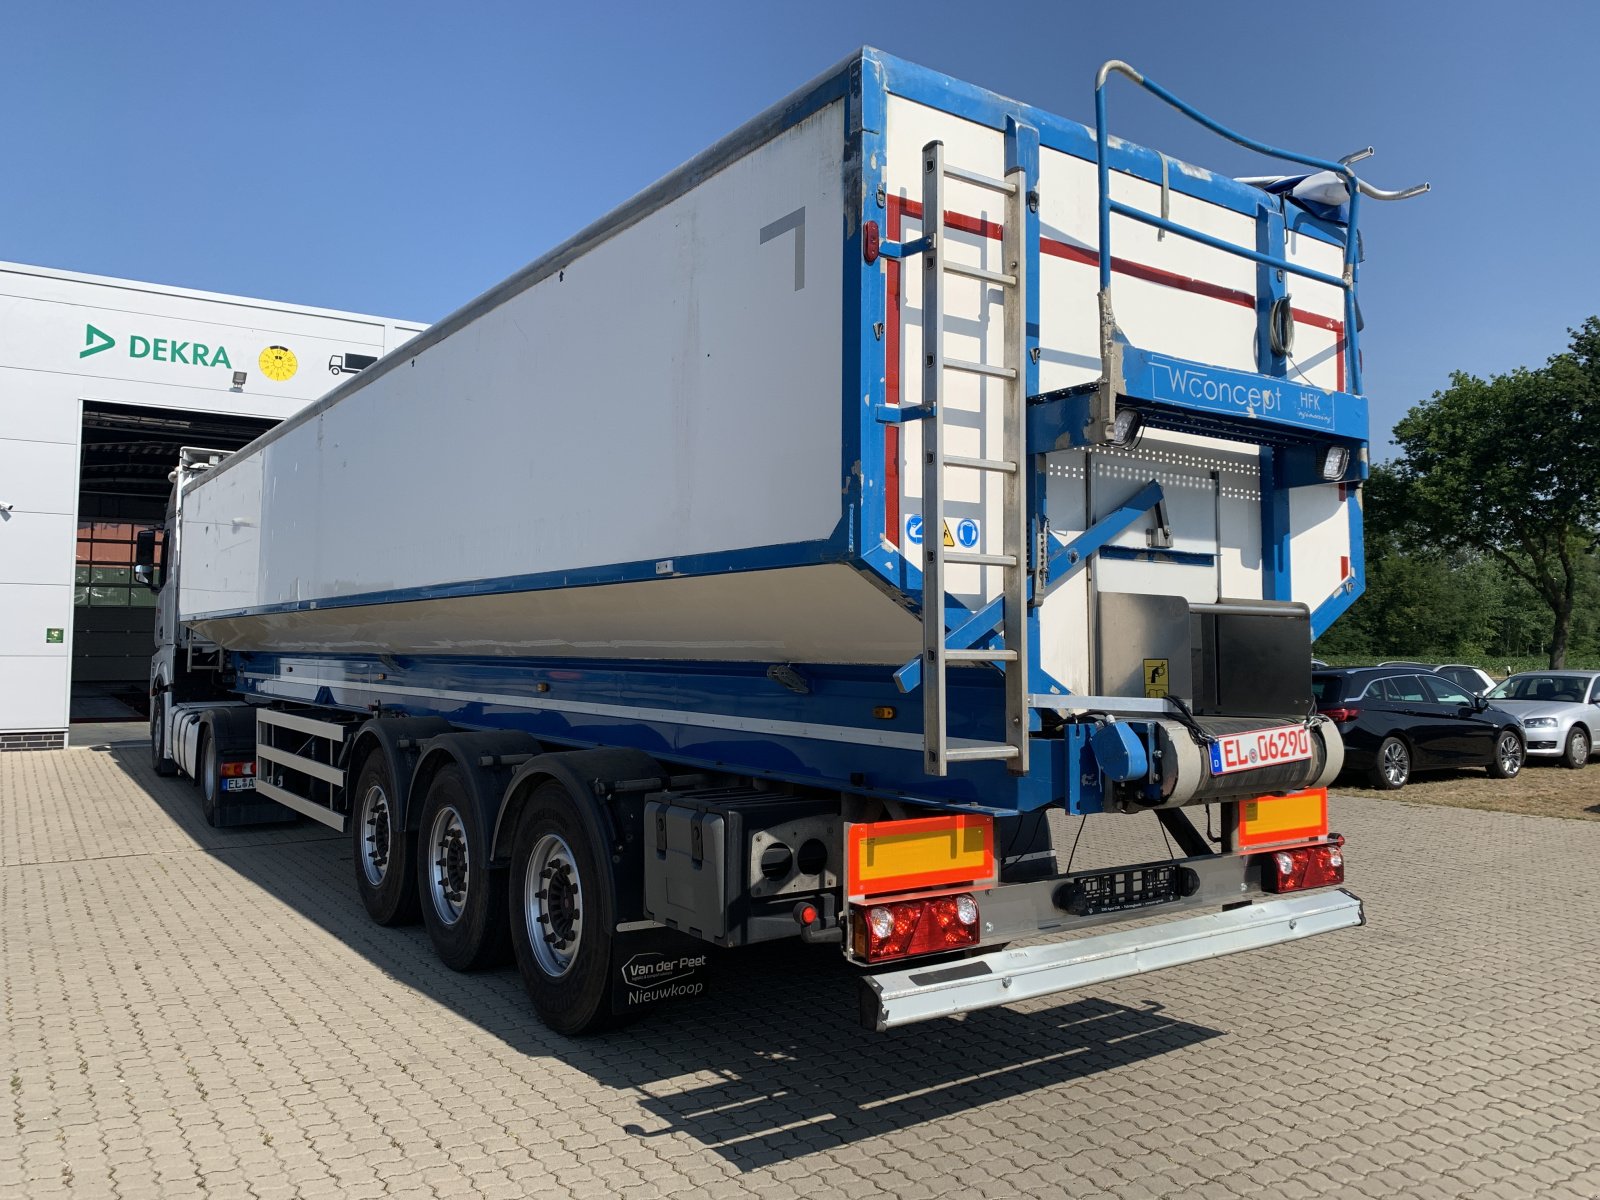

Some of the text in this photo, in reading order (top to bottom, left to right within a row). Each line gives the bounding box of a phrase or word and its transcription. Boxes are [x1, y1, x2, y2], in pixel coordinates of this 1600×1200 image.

[129, 335, 232, 369] DEKRA
[1162, 363, 1281, 414] Wconcept
[1300, 391, 1320, 411] HFK
[1214, 729, 1308, 768] D EL 06290
[228, 779, 242, 789] EL
[630, 964, 654, 976] Van
[656, 960, 678, 972] der
[679, 955, 707, 969] Peet
[628, 982, 703, 1005] Nieuwkoop
